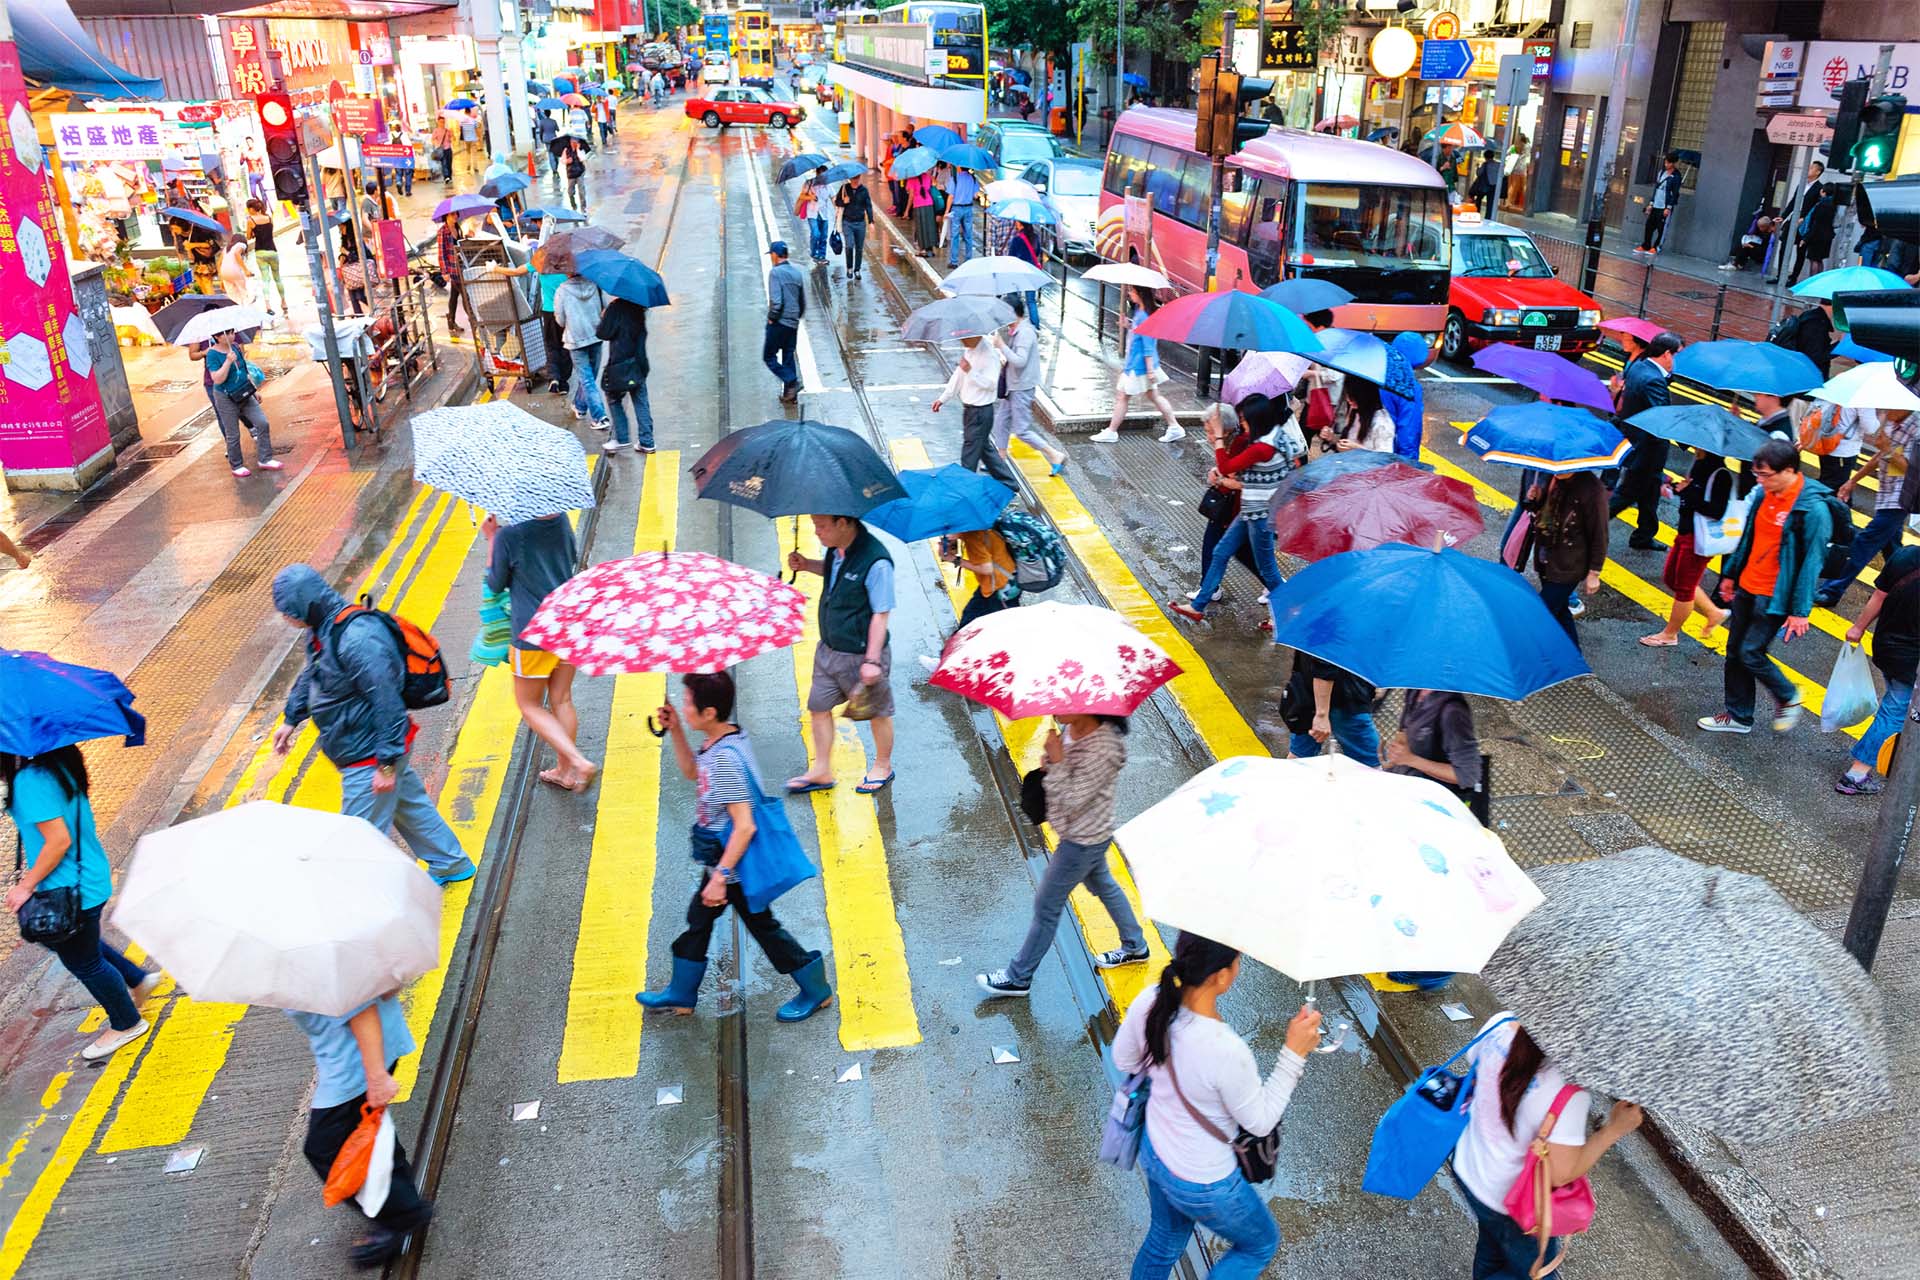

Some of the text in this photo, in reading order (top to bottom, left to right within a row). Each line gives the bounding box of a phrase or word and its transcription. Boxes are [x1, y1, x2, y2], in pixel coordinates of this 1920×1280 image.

[230, 25, 266, 95] 卓悅
[293, 40, 331, 73] BONJOUR
[1774, 61, 1794, 70] NCB
[1857, 64, 1909, 89] NB
[1787, 119, 1814, 128] Johnston
